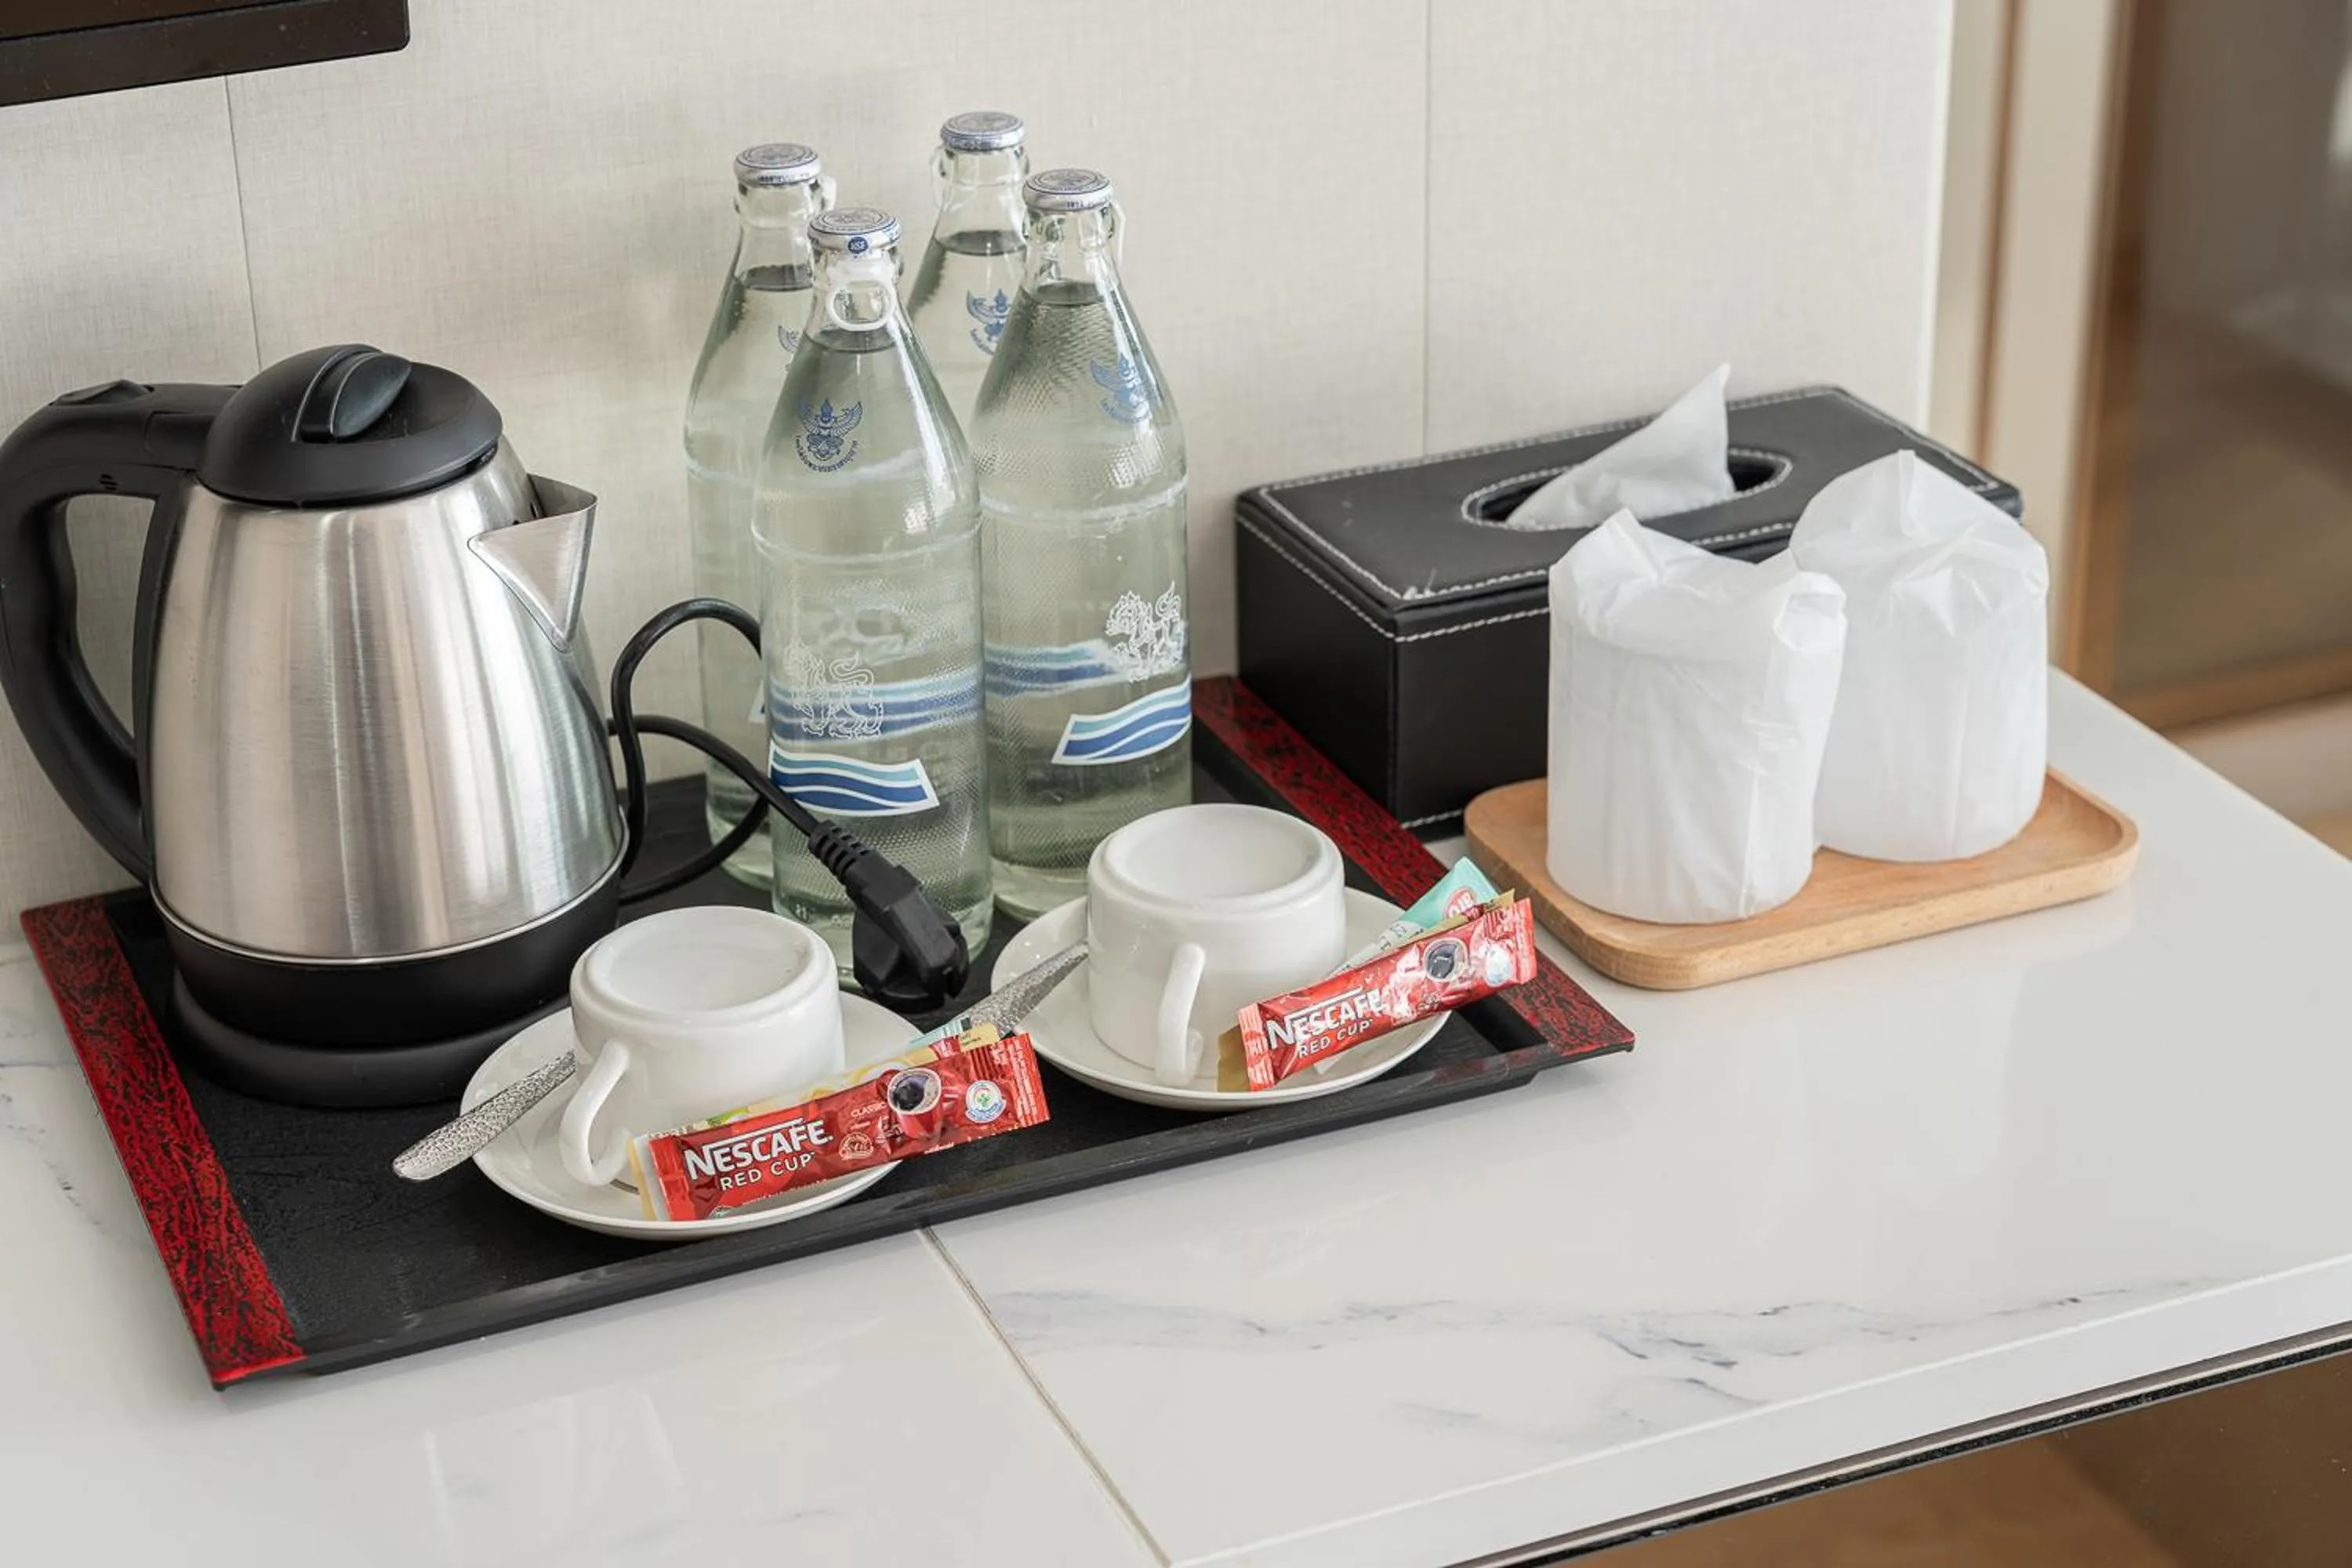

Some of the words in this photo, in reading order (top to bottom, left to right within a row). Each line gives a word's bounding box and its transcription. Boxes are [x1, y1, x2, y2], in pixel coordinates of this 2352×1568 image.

[1298, 1036, 1330, 1058] RED
[1337, 1021, 1370, 1041] CUP
[851, 1101, 887, 1118] CLASSIC
[720, 1169, 762, 1191] RED
[771, 1153, 812, 1176] CUP
